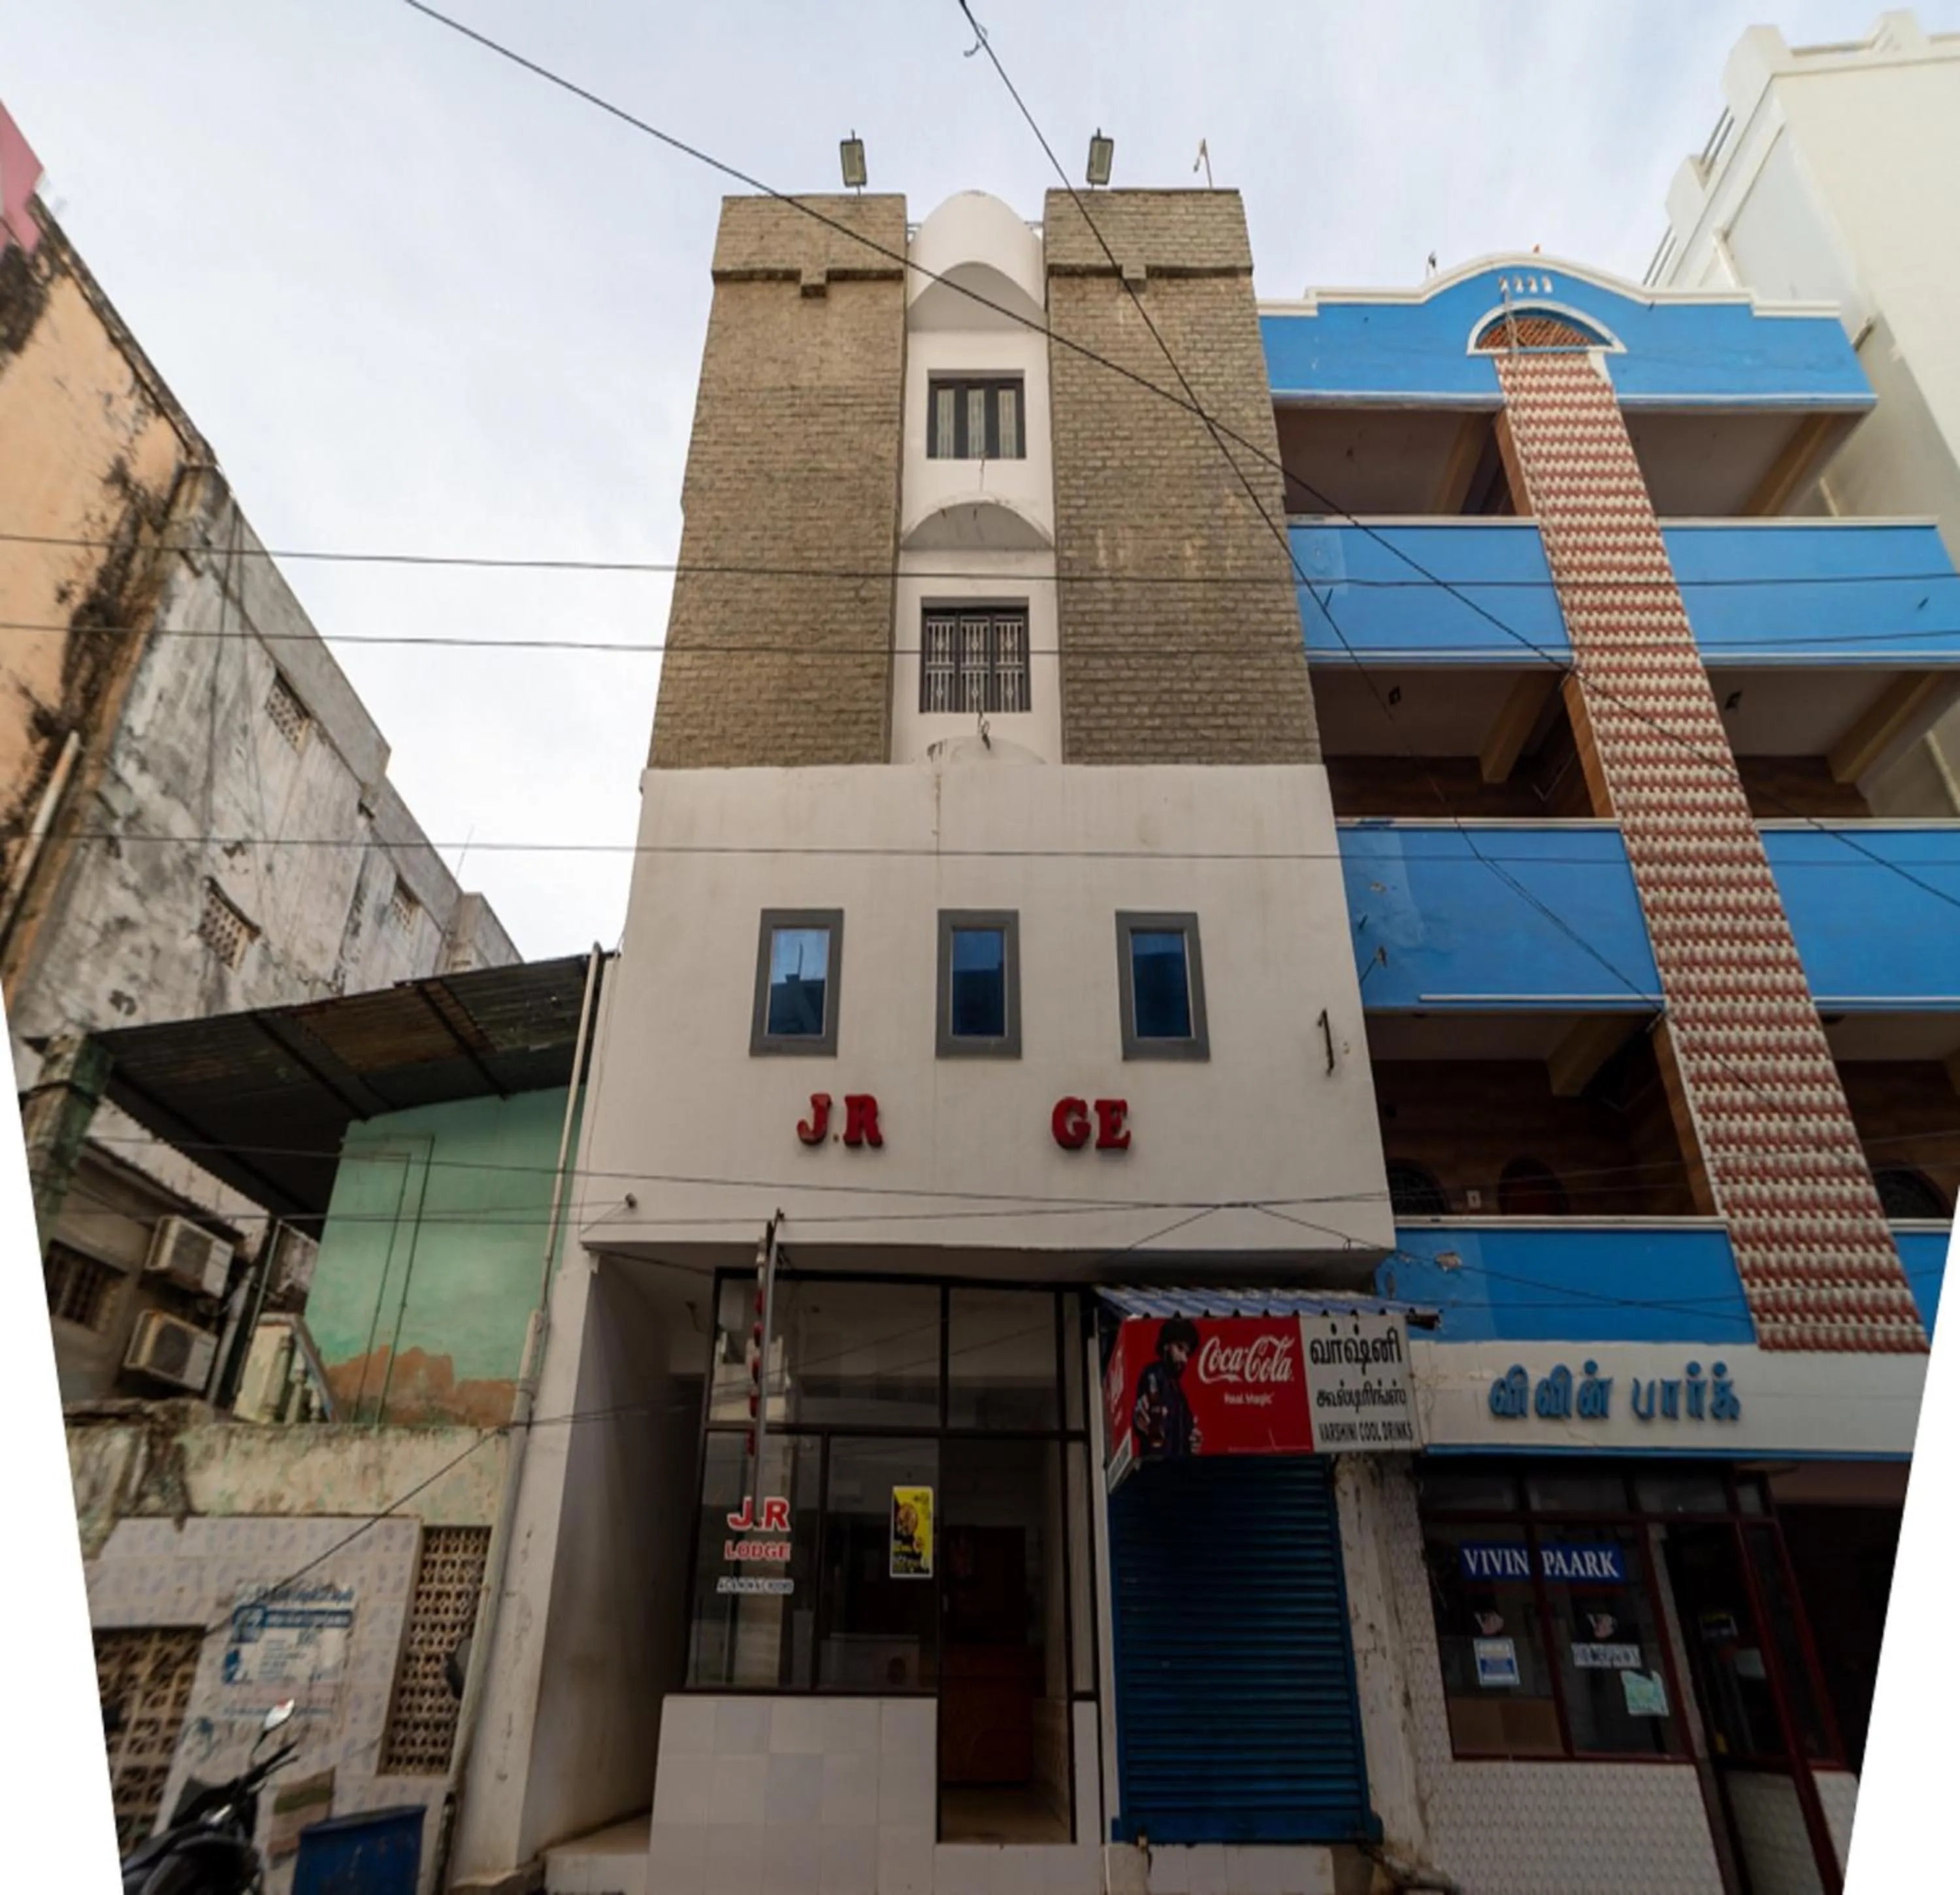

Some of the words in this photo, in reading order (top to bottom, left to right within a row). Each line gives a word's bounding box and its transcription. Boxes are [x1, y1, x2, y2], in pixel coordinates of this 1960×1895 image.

[1051, 1096, 1131, 1150] GE
[1198, 1336, 1295, 1383] Coca-Cola
[1488, 1359, 1614, 1420] விவின்
[1631, 1361, 1742, 1422] பார்க்
[725, 1540, 792, 1561] LODGE
[1463, 1548, 1530, 1575] VIVIN
[1540, 1550, 1620, 1579] PAARK
